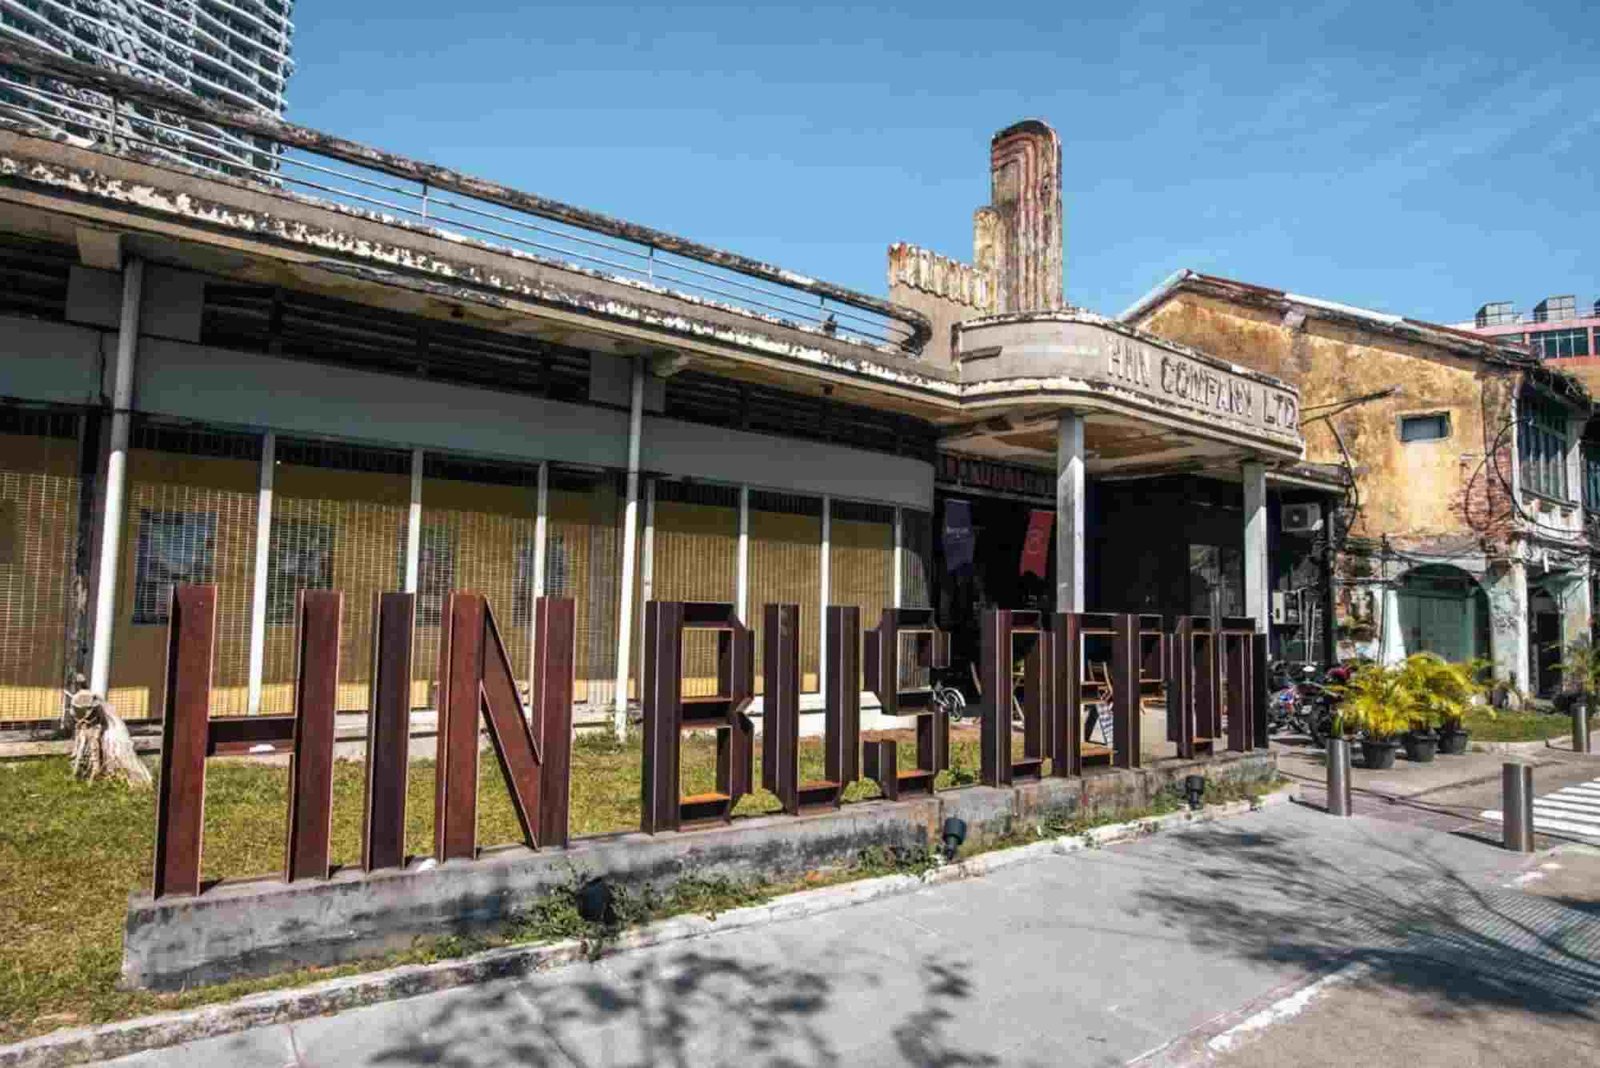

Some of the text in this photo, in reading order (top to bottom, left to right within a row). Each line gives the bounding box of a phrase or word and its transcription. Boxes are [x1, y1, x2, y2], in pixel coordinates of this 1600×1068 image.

[1106, 336, 1150, 388] HIN
[1161, 356, 1252, 418] COMPANY
[154, 583, 1269, 899] HIN BUS DEPOT
